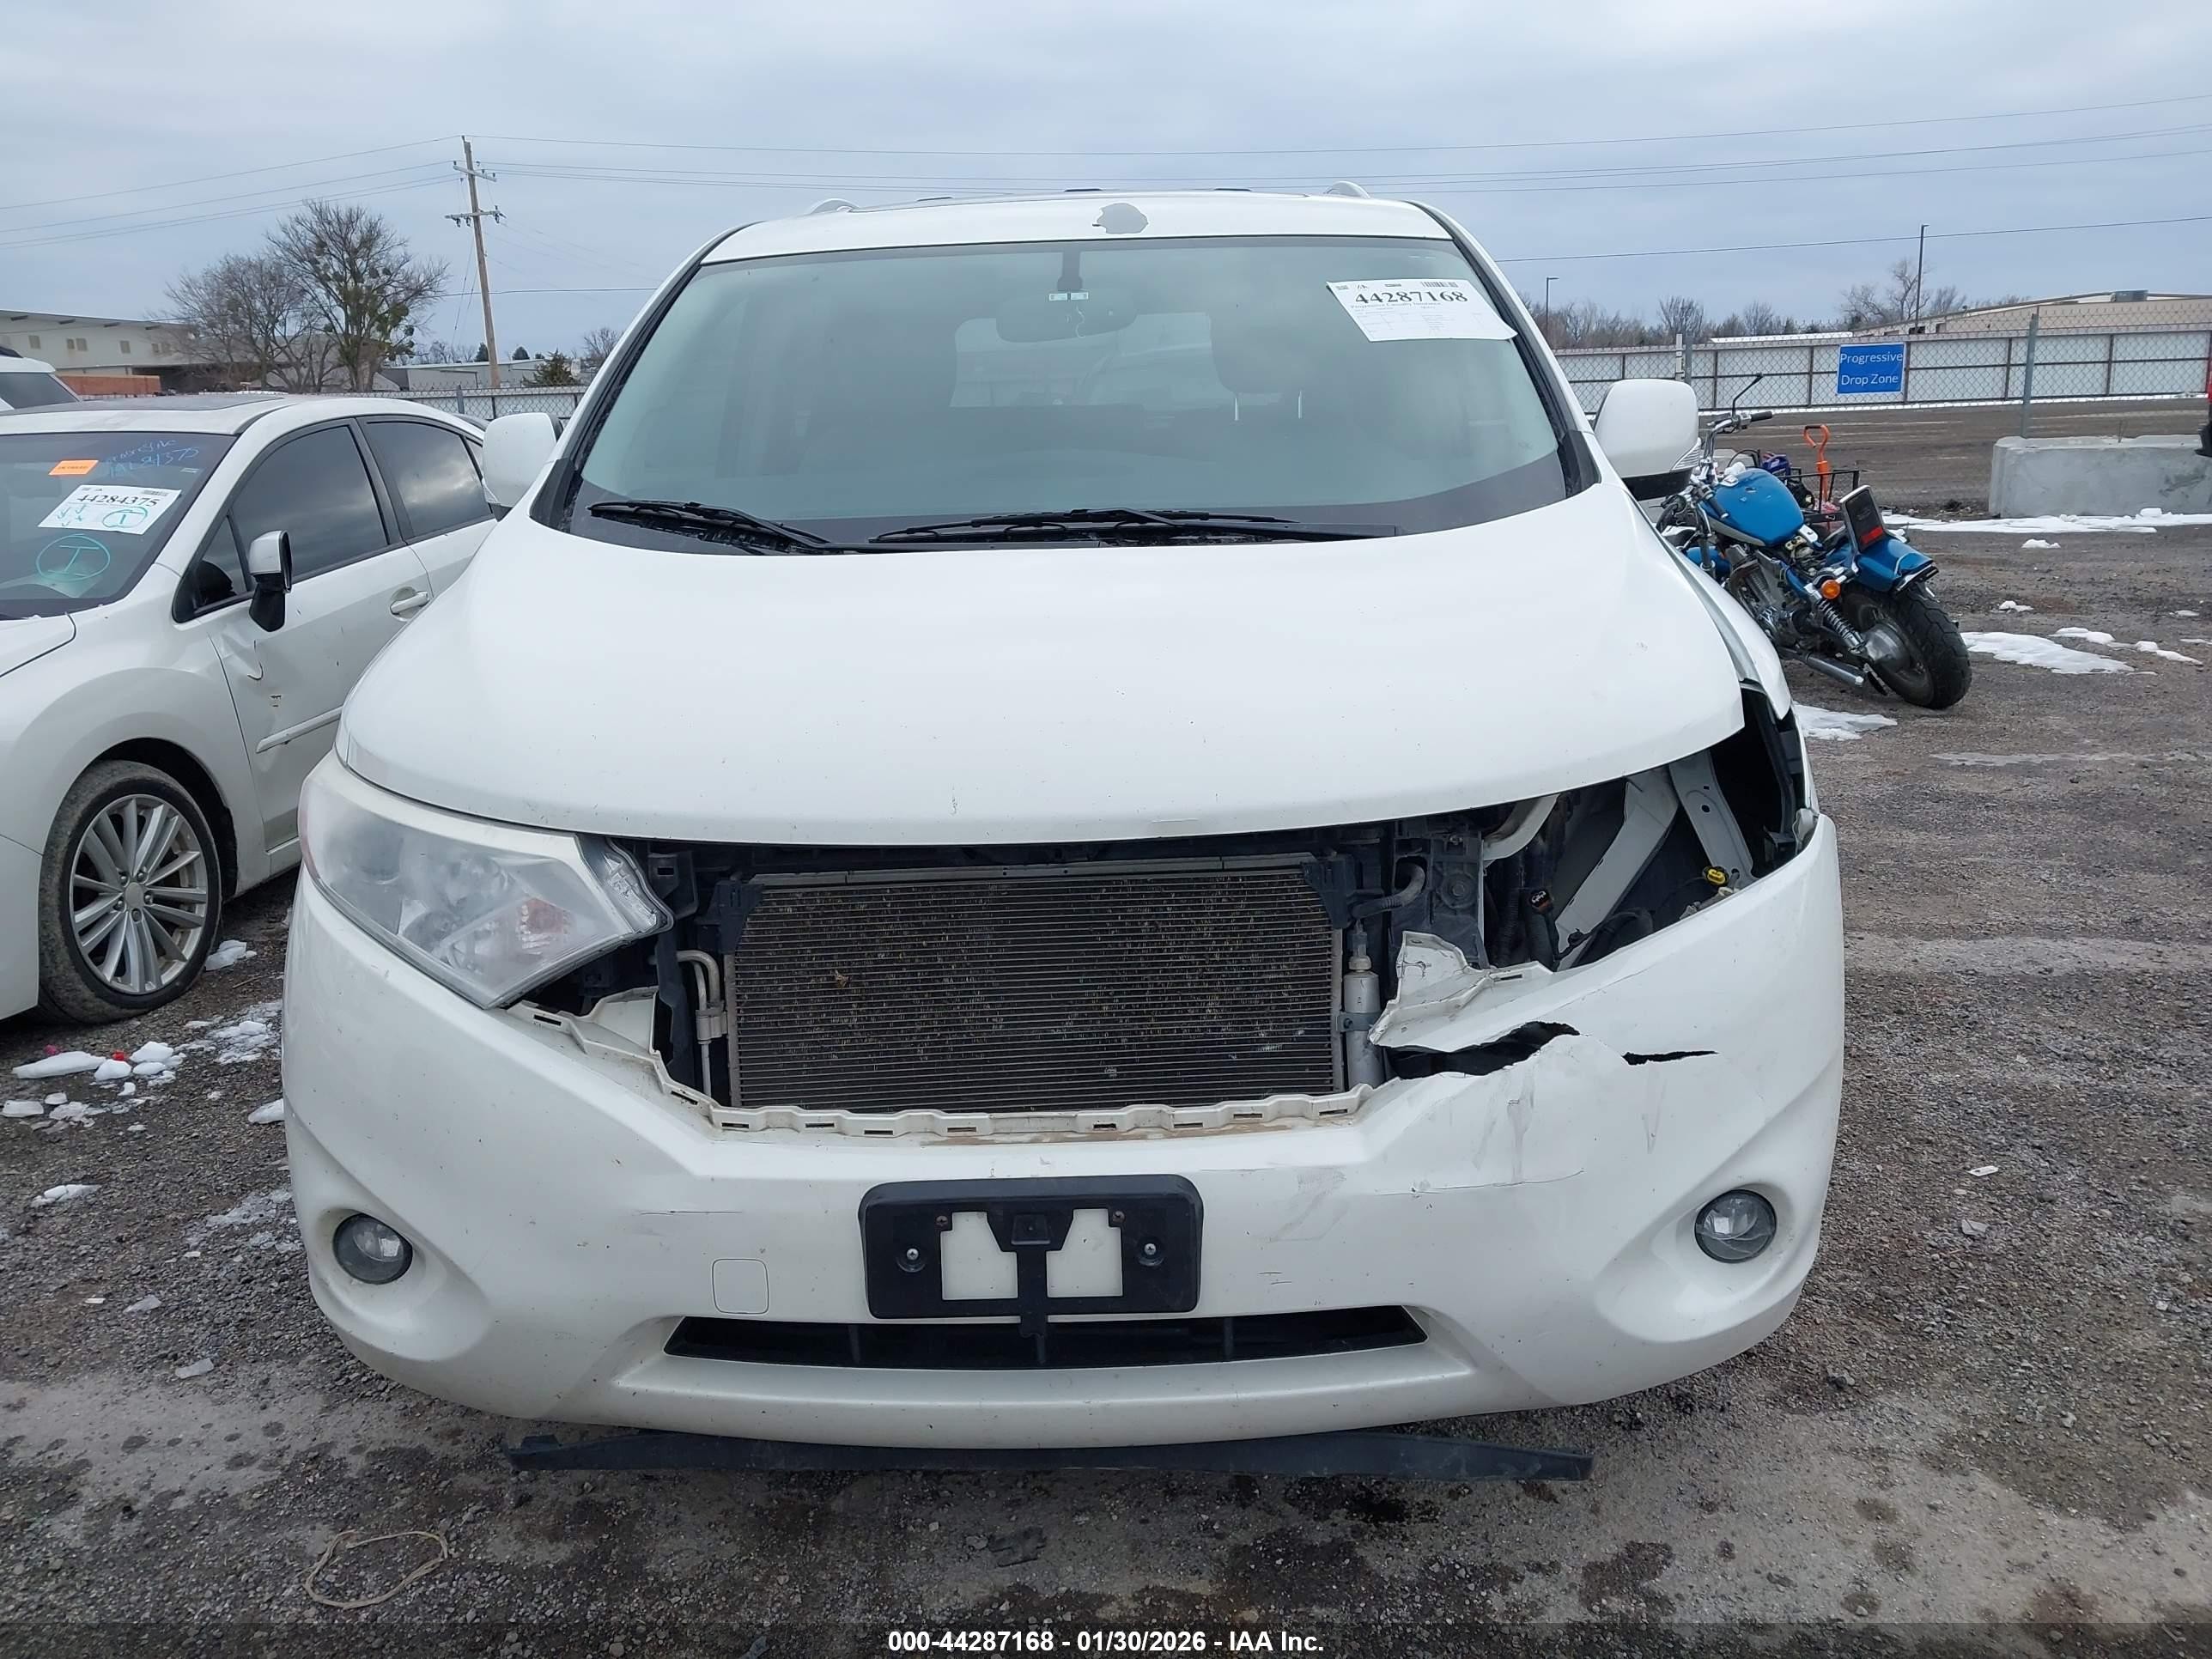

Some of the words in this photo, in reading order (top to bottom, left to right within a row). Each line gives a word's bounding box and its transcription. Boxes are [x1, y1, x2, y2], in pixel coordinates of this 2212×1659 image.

[1355, 290, 1468, 304] 44287168
[1840, 351, 1904, 365] Progressive
[1841, 374, 1869, 386] Drop
[1870, 374, 1899, 384] Zone
[76, 494, 161, 507] 44284375
